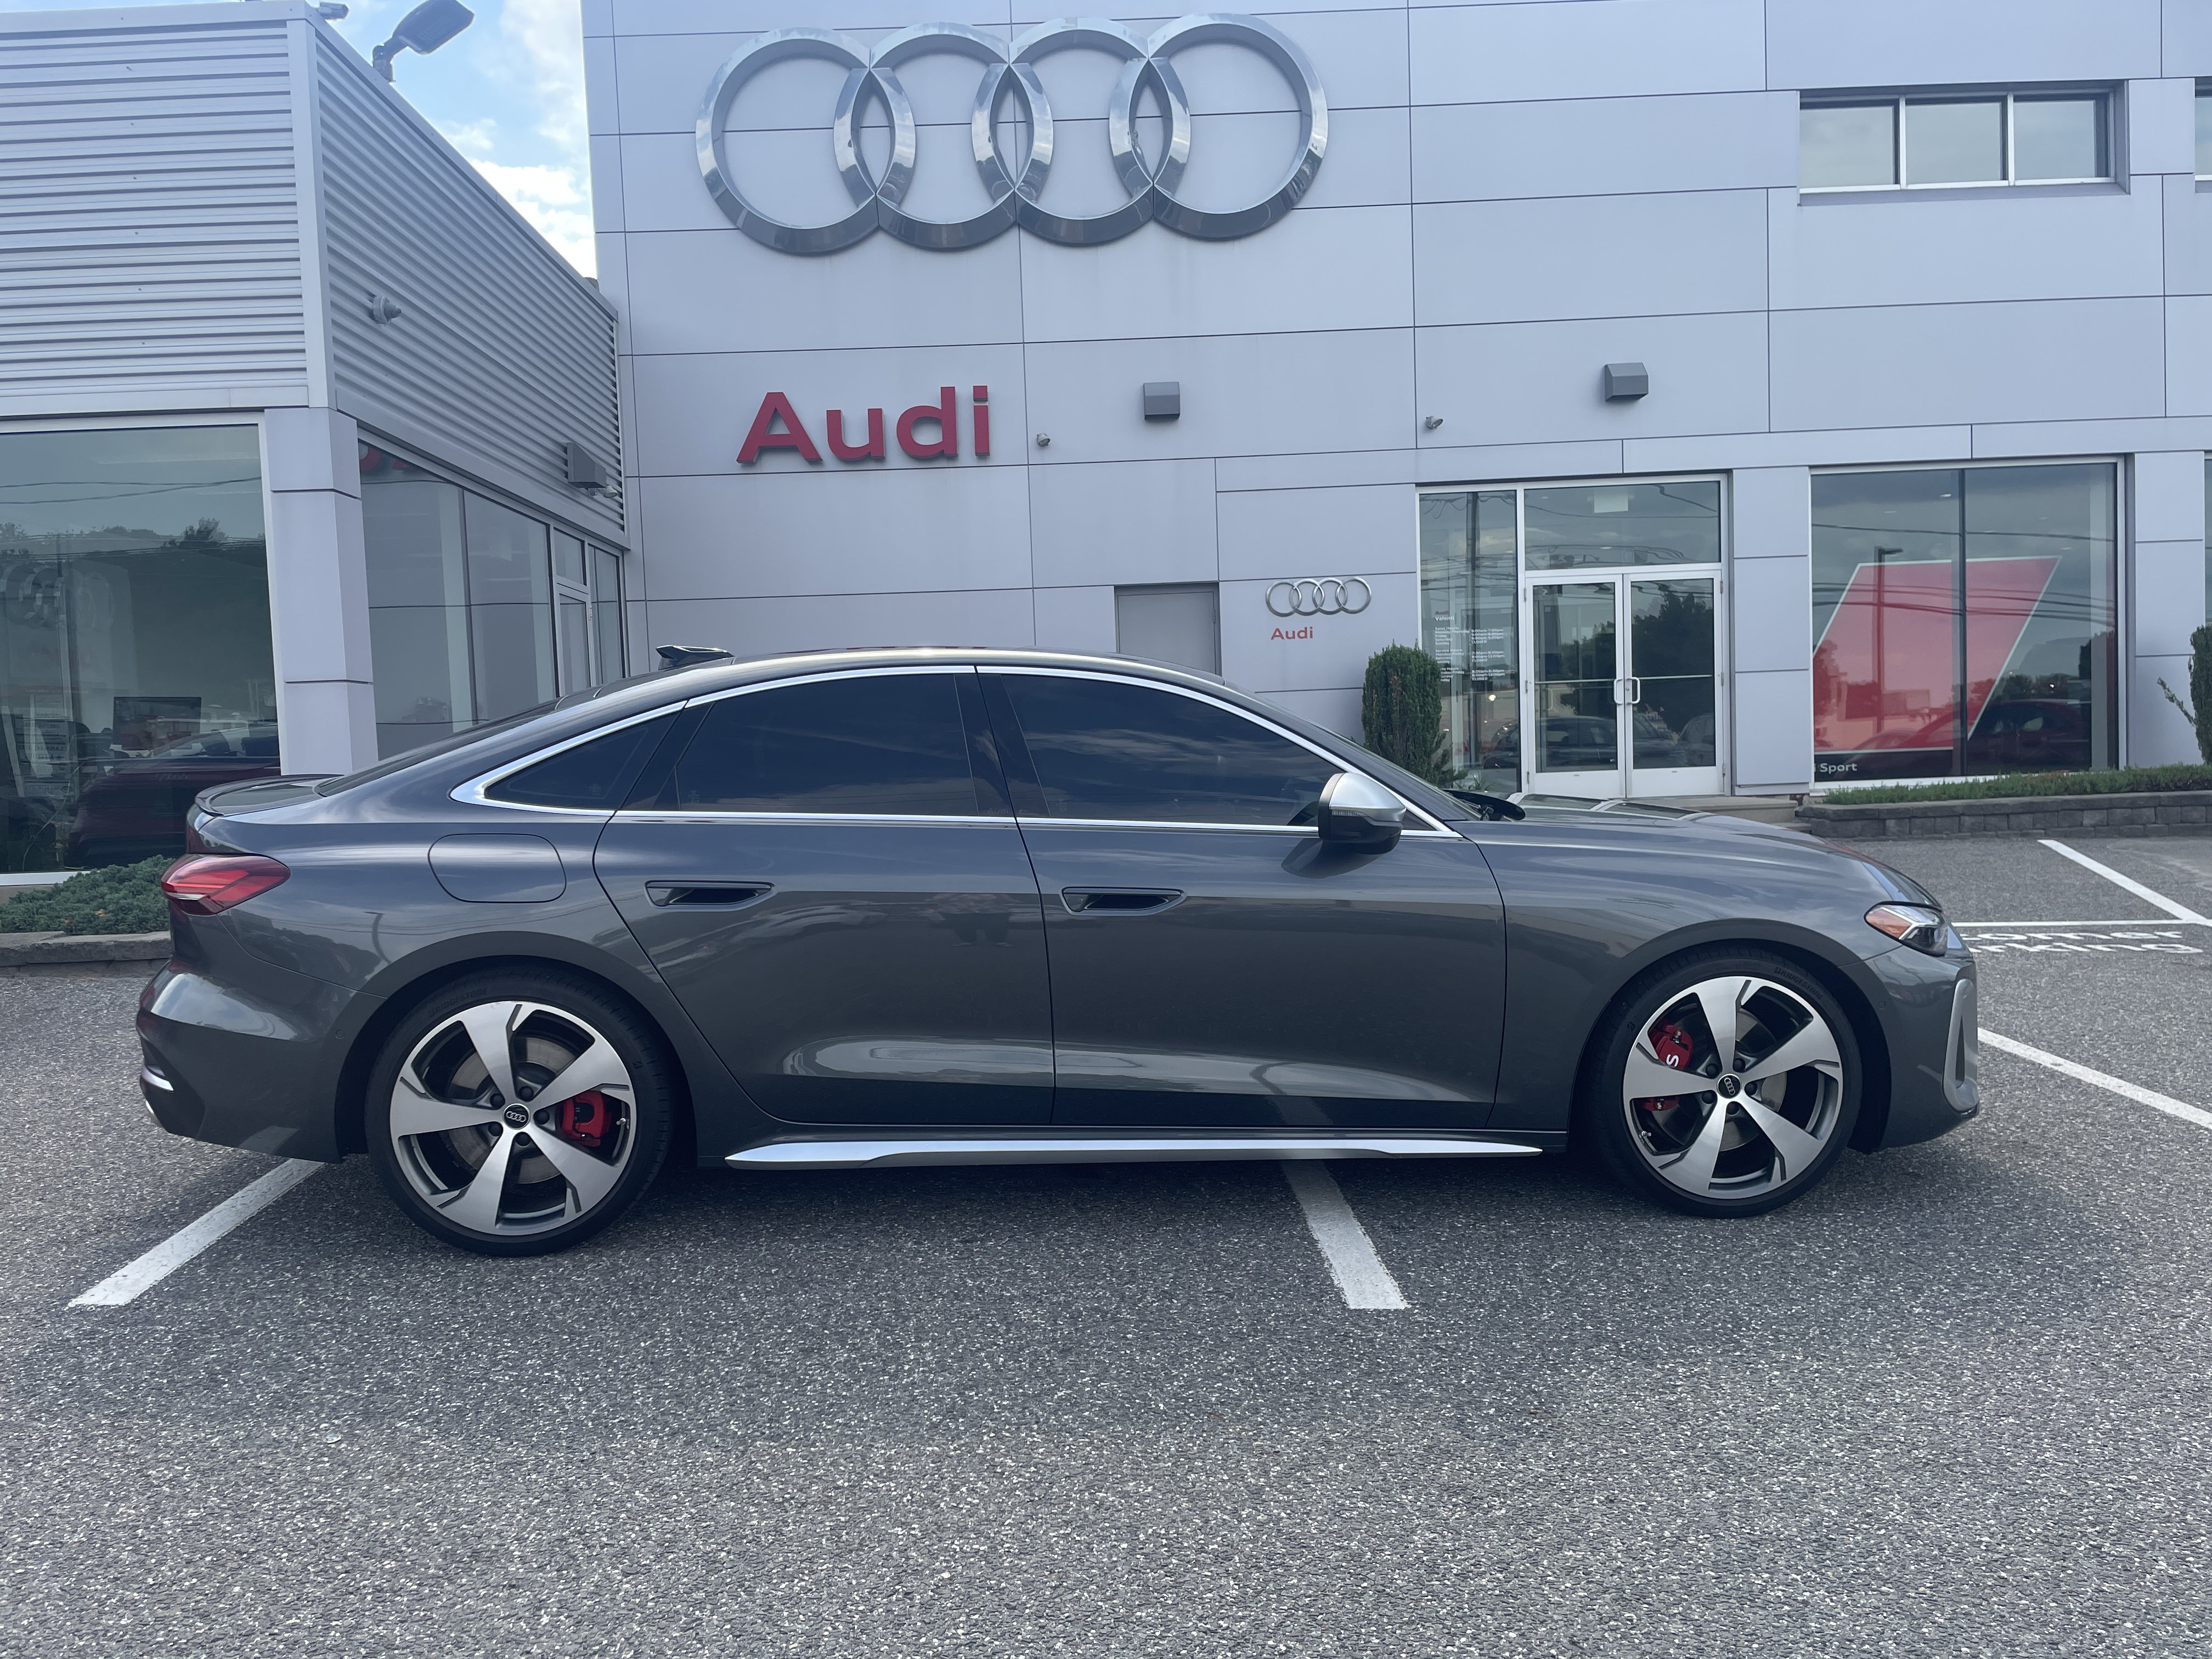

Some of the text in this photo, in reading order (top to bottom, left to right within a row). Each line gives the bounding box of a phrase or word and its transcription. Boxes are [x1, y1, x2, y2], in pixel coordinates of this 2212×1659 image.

[736, 385, 990, 464] Audi
[1271, 627, 1313, 640] Audi
[1820, 763, 1858, 775] Sport
[1968, 942, 2204, 954] rking
[1773, 967, 1824, 1000] BRIDGESTONE
[1666, 1054, 1679, 1067] S
